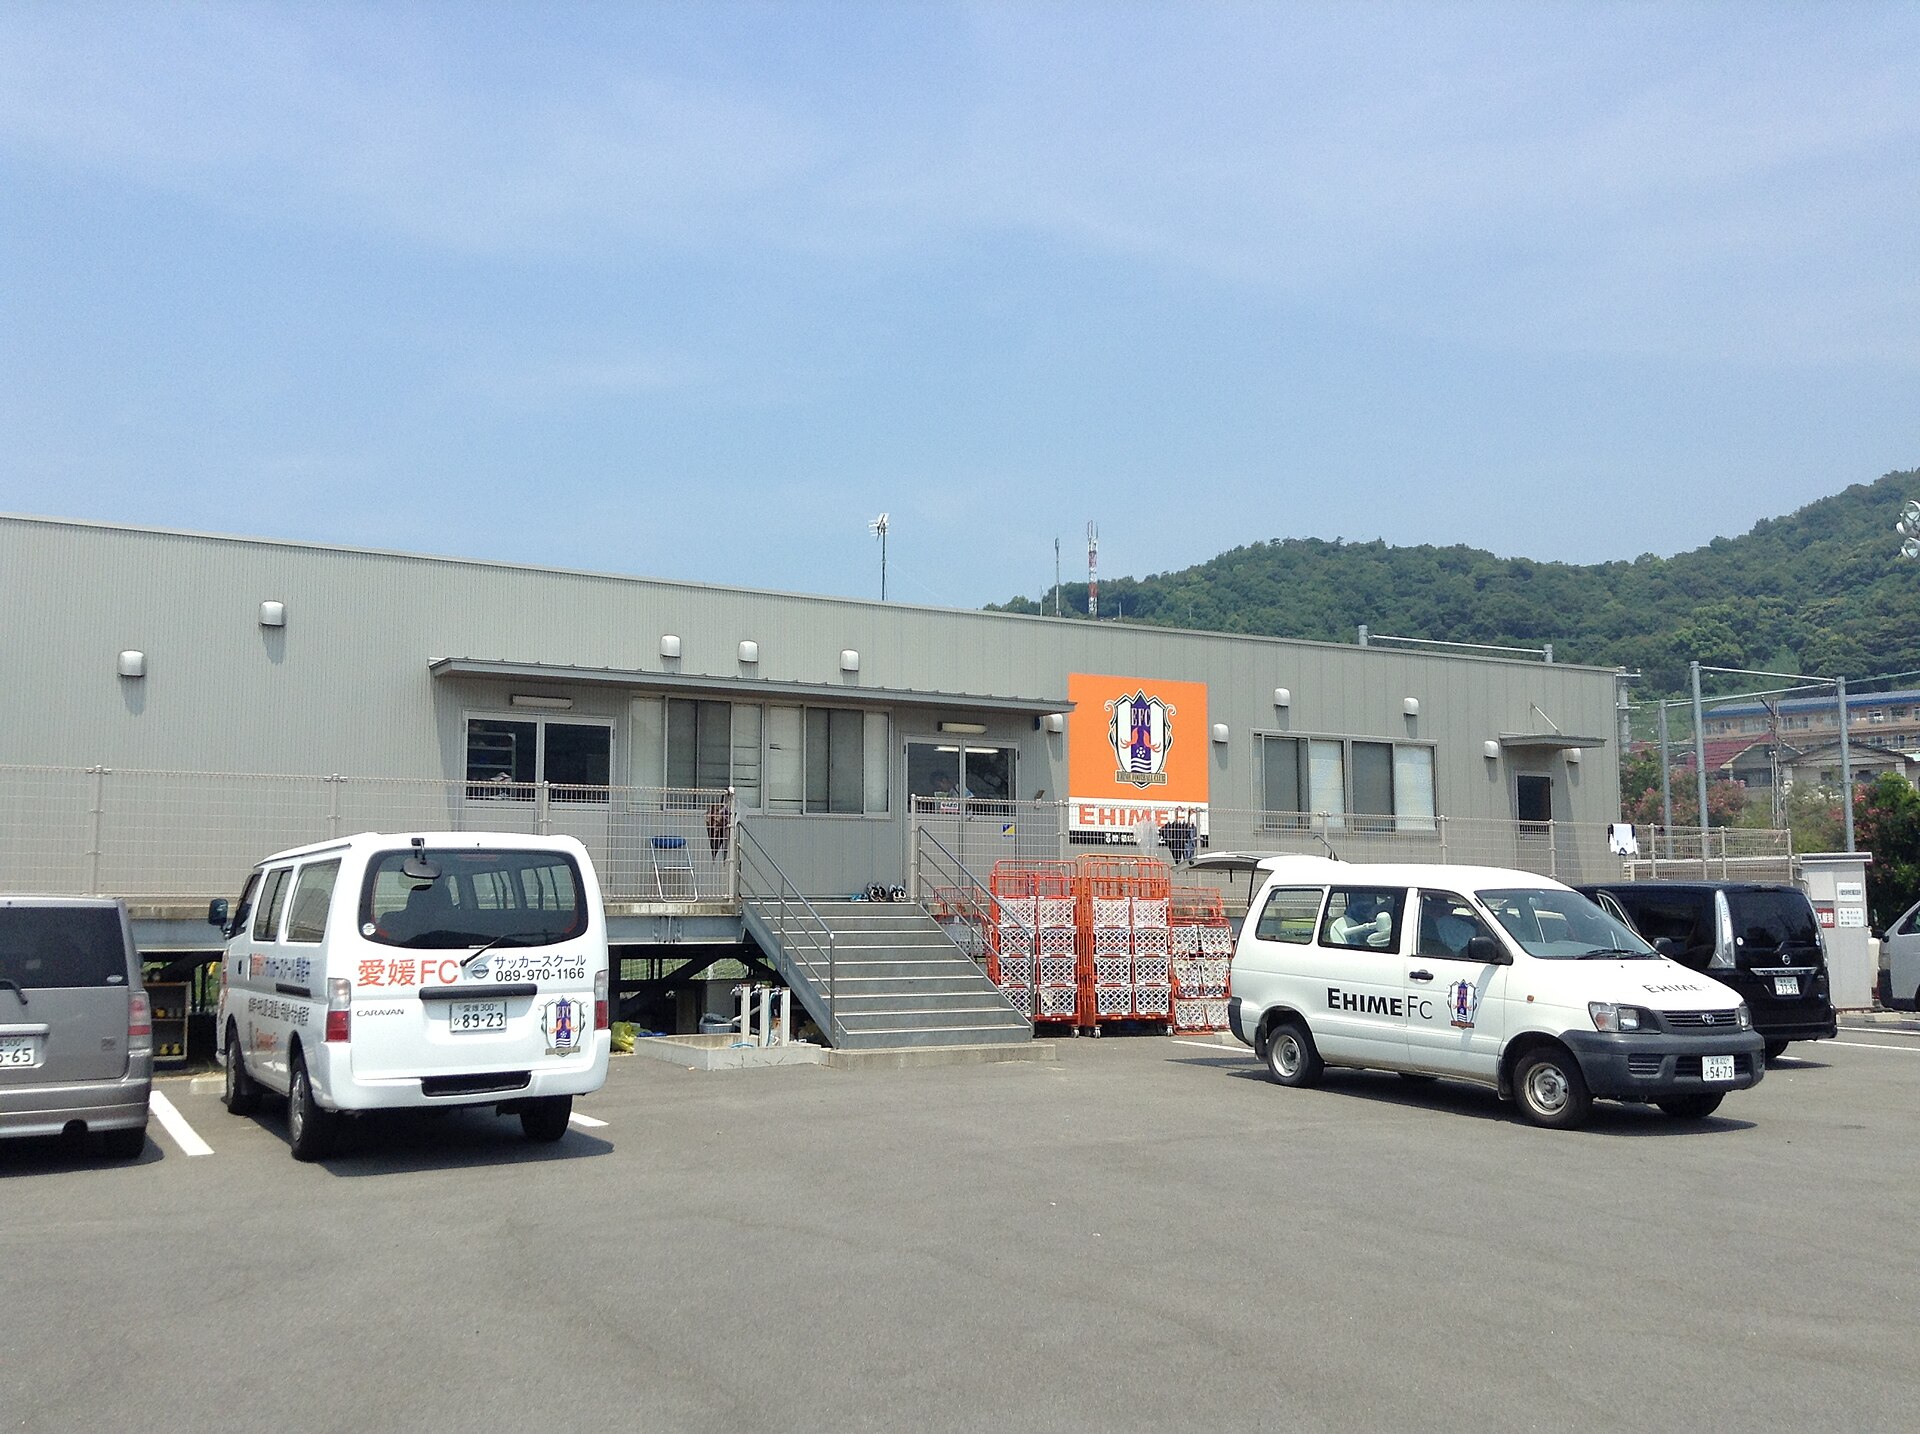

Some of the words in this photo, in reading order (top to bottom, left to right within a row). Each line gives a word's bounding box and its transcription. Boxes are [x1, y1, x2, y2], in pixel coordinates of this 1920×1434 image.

[1131, 708, 1151, 727] EFC
[494, 954, 587, 970] サッカースクール
[357, 959, 458, 987] 愛媛FC
[495, 967, 585, 982] 089-970-1166
[356, 1009, 404, 1017] CARAVAN
[480, 1003, 494, 1012] 300
[463, 1012, 504, 1029] 89-23
[1710, 1065, 1733, 1079] 54-73
